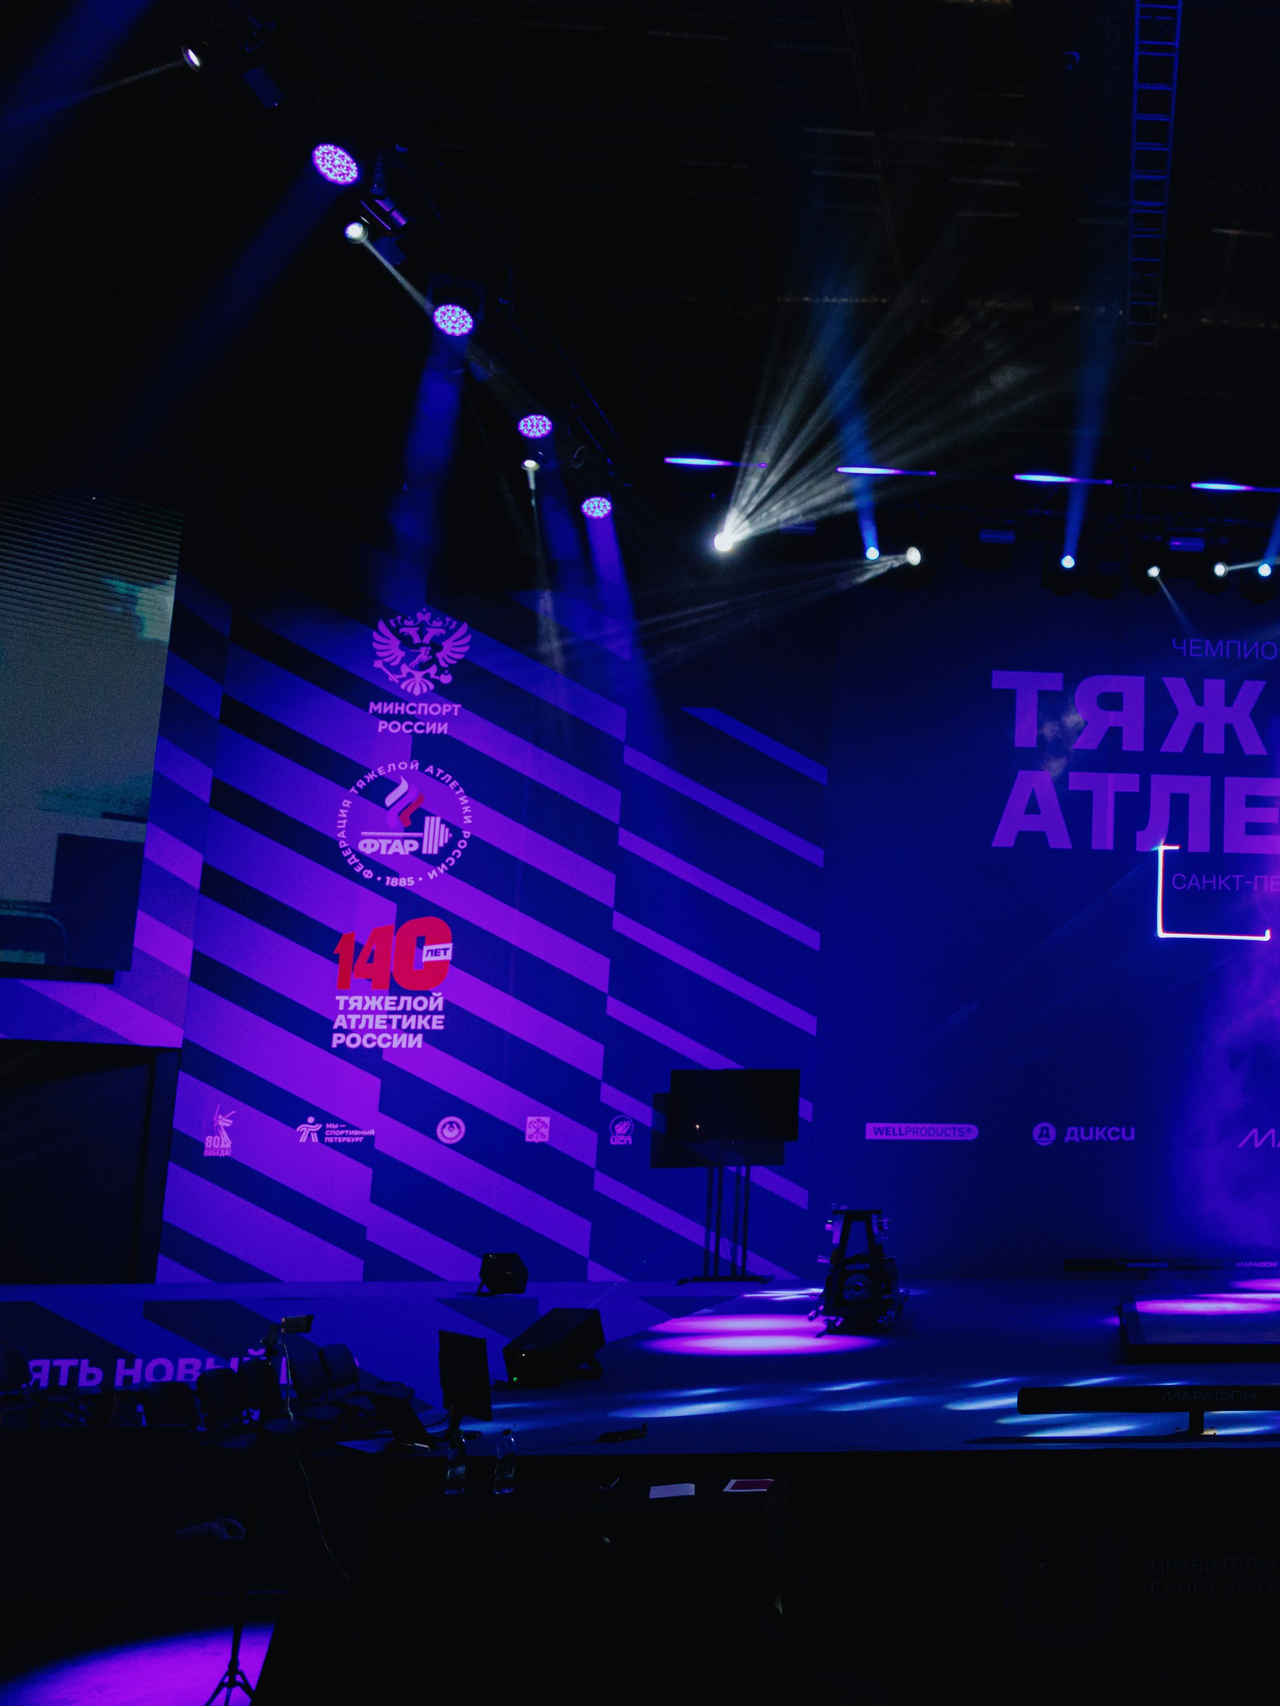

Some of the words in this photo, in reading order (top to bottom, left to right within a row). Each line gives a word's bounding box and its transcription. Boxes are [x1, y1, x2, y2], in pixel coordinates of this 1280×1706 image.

[368, 701, 462, 716] МИНСПОРТ
[378, 720, 449, 735] РОССИИ
[349, 759, 420, 795] ТЯЖЕЛОЙ
[424, 764, 473, 824] АТЛЕТИКИ
[337, 798, 374, 880] ФЕДЕРАЦИЯ
[358, 838, 420, 855] ФТАР
[427, 830, 471, 880] РОССИИ
[385, 876, 415, 887] 1885
[333, 916, 452, 991] 140
[425, 947, 450, 958] ЛЕТ
[335, 992, 444, 1011] ТЯЖЕЛОЙ
[332, 1014, 445, 1030] АТЛЕТИКЕ
[331, 1032, 424, 1049] РОССИИ
